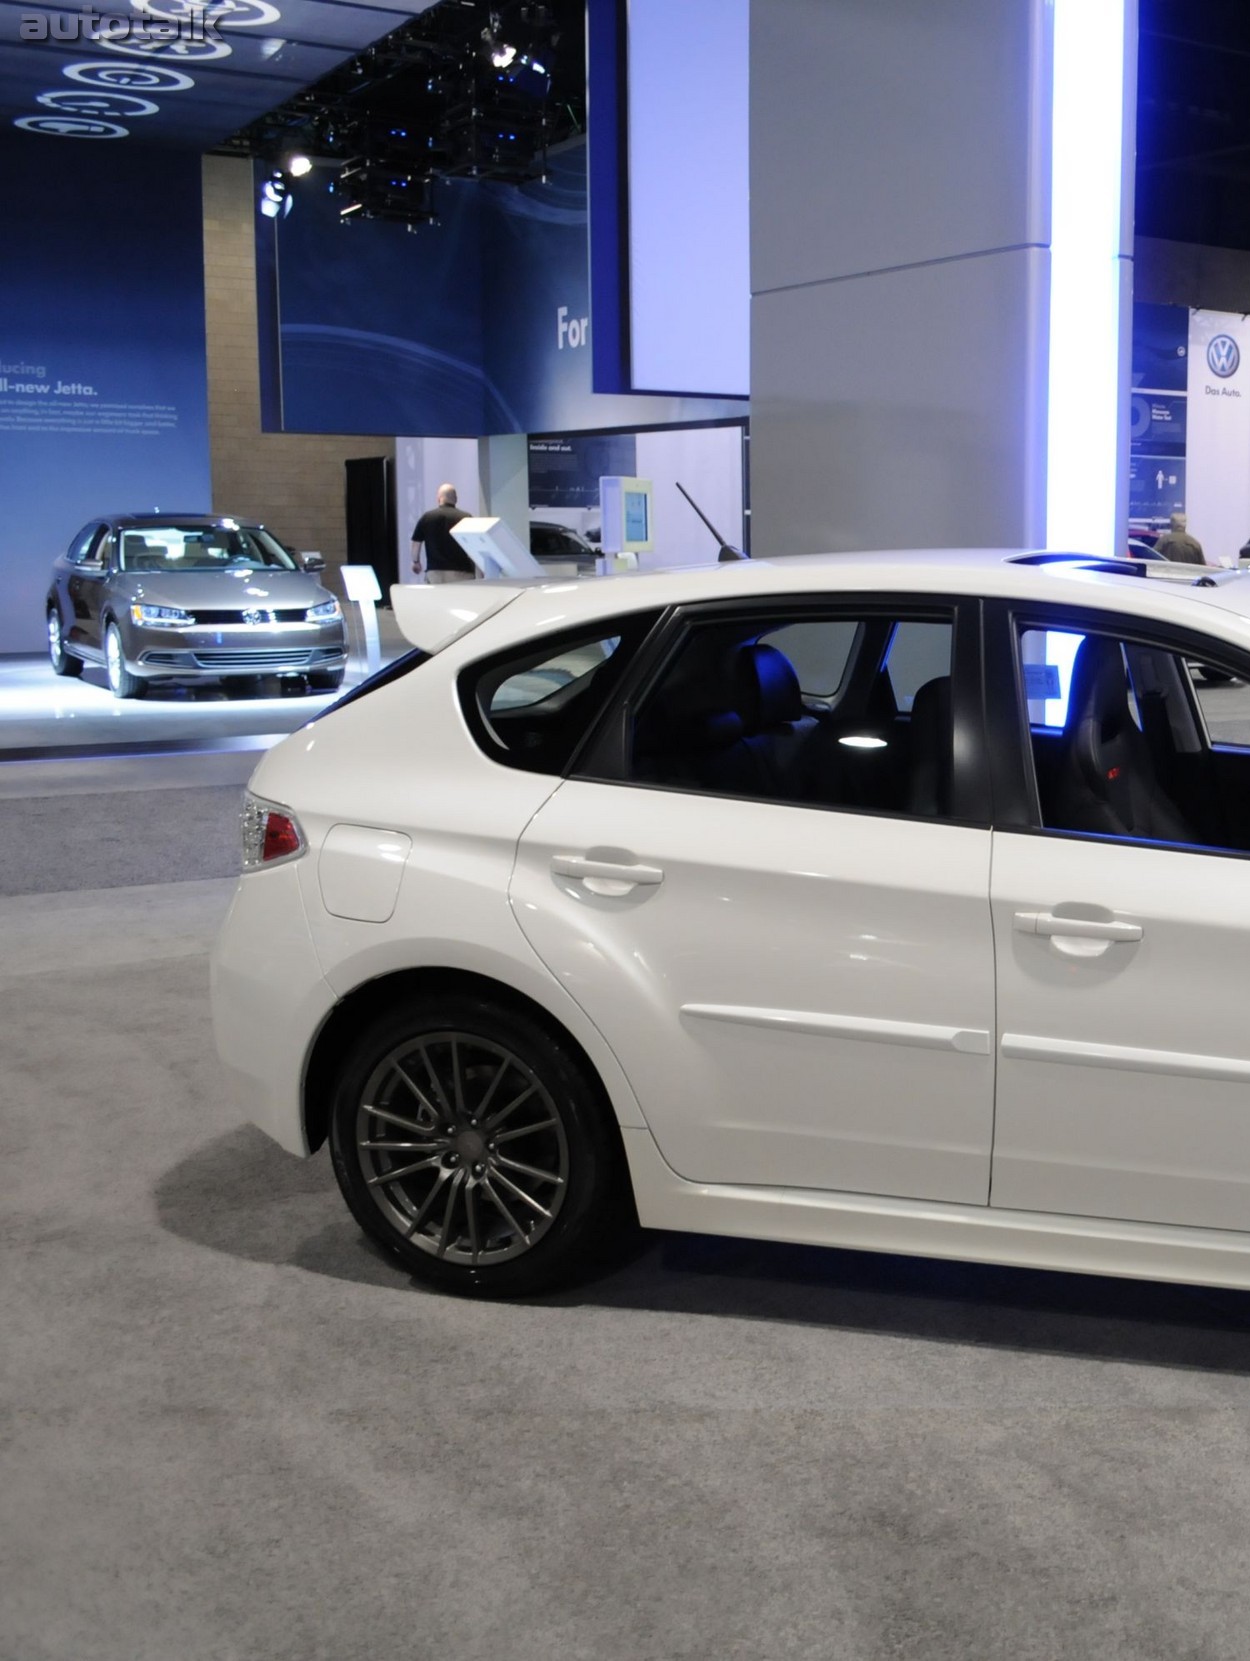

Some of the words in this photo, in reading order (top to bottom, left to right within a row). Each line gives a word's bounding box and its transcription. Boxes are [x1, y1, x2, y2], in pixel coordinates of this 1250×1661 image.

[557, 306, 589, 350] For
[0, 359, 47, 379] ucing
[53, 380, 98, 396] Jetta.
[1205, 385, 1220, 396] Das
